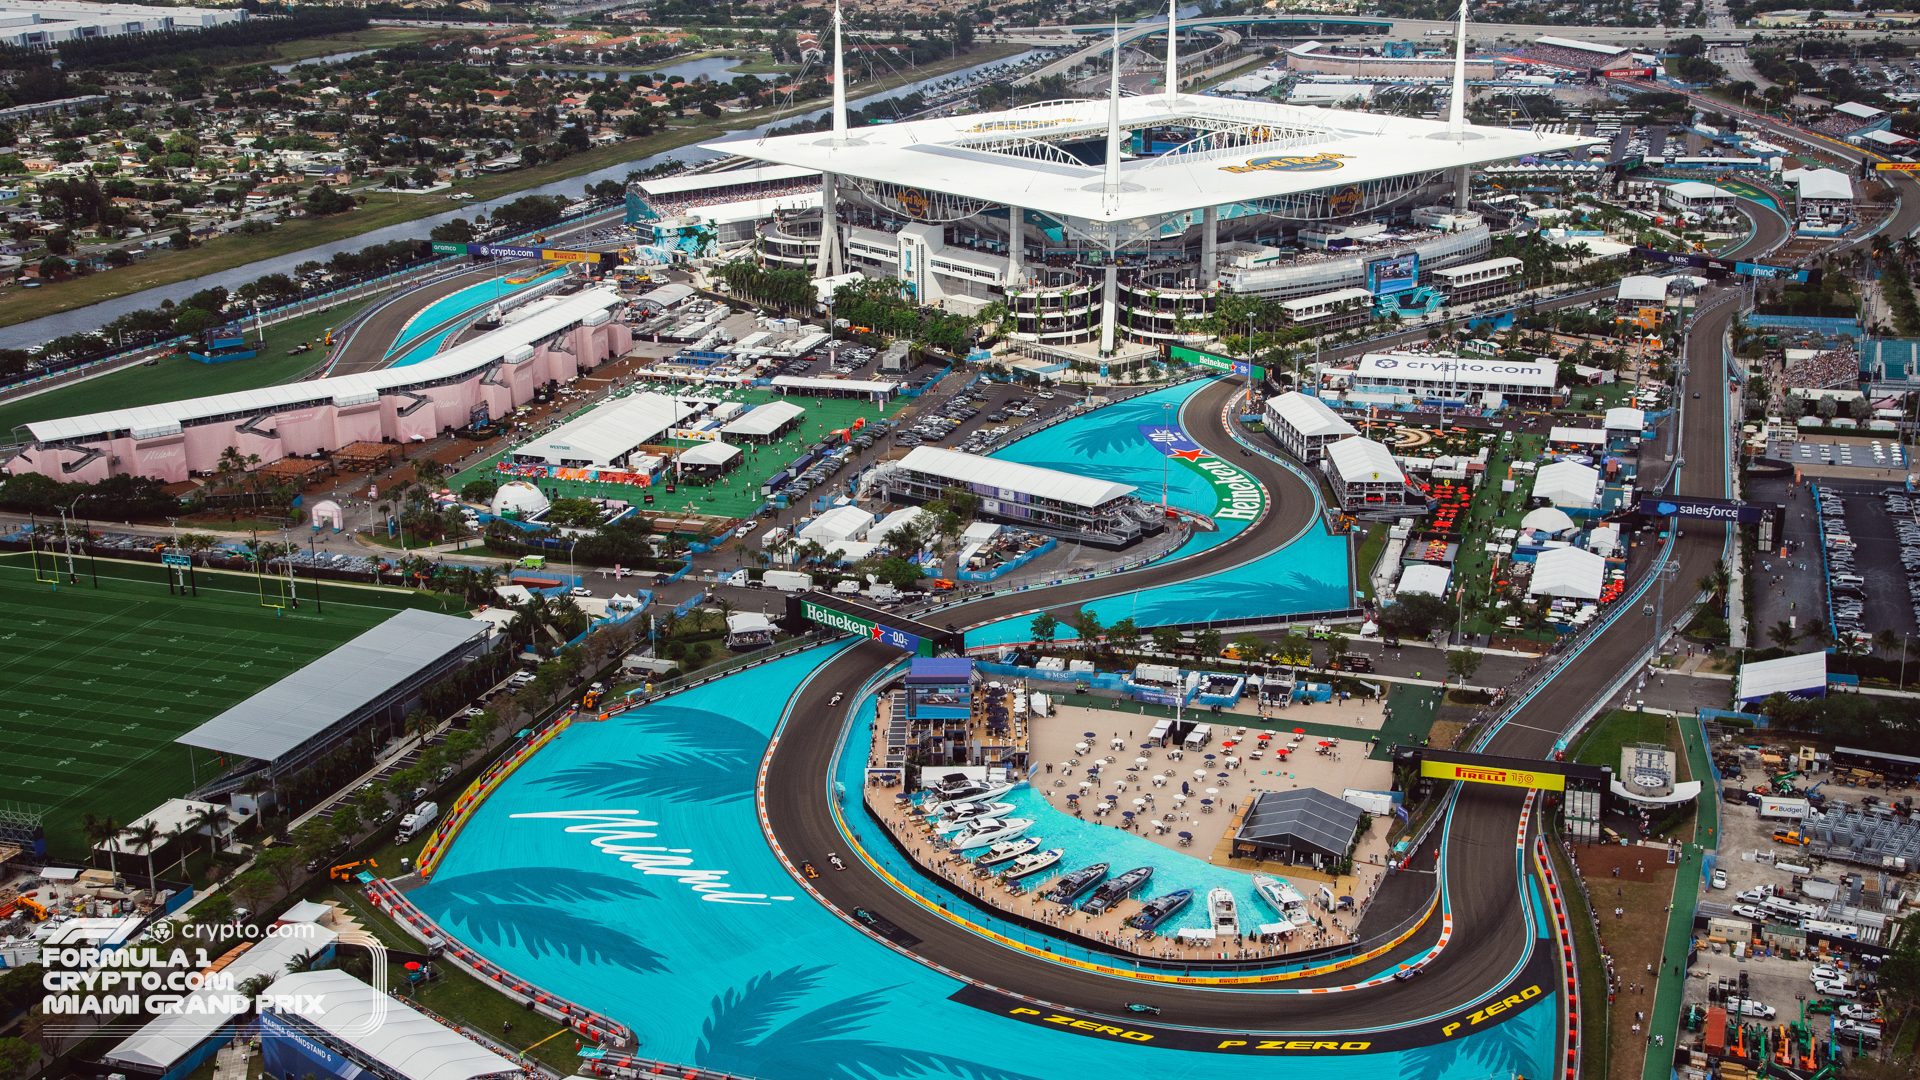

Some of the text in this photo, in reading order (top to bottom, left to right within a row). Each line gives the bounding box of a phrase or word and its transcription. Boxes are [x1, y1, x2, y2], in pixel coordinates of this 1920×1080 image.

[490, 247, 534, 258] crypto.com
[554, 252, 577, 260] PIRELLI
[1199, 355, 1229, 369] Heineken
[1406, 361, 1542, 375] crypto.com
[1198, 461, 1260, 520] Heineken
[1679, 504, 1738, 518] salesforce
[806, 604, 868, 636] Heineken
[1455, 767, 1534, 784] PIRELLI 150
[1778, 805, 1803, 814] Budget
[508, 809, 795, 905] Miami
[1442, 985, 1541, 1037] P ZERO
[1009, 1007, 1154, 1041] P ZERO
[262, 1016, 286, 1034] MARINA
[286, 1030, 326, 1058] GRANDSTAND
[326, 1054, 332, 1062] 6
[1218, 1040, 1371, 1050] P ZERO
